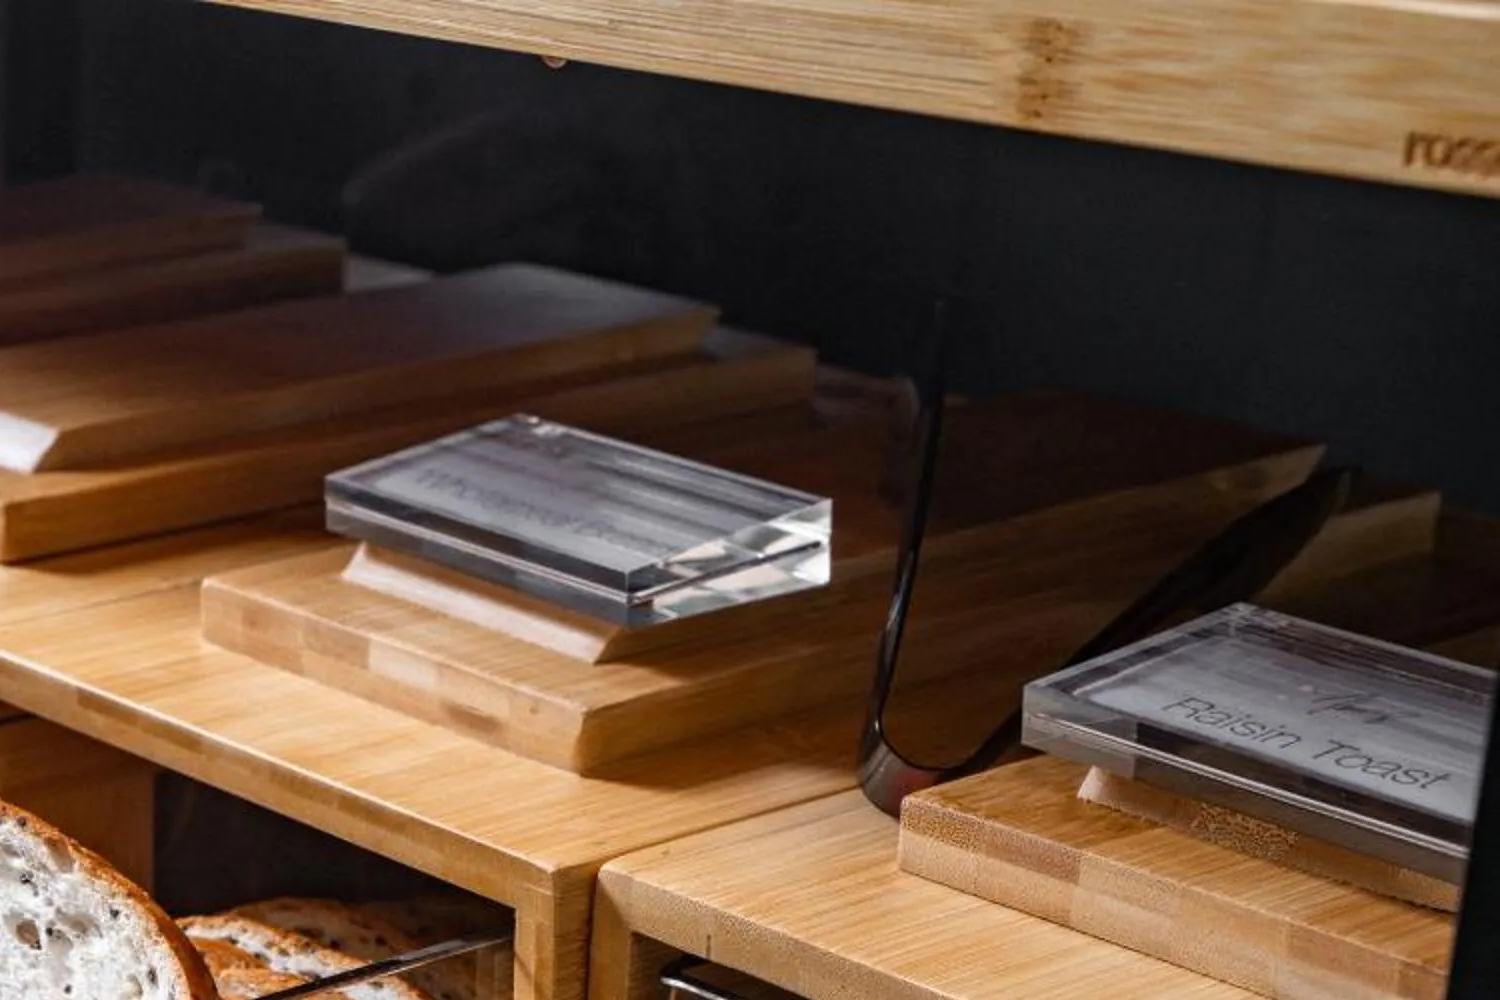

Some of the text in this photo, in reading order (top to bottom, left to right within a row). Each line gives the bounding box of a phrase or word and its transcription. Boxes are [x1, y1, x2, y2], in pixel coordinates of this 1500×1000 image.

[1404, 130, 1500, 177] ross
[1160, 696, 1452, 791] Raisin Toast
